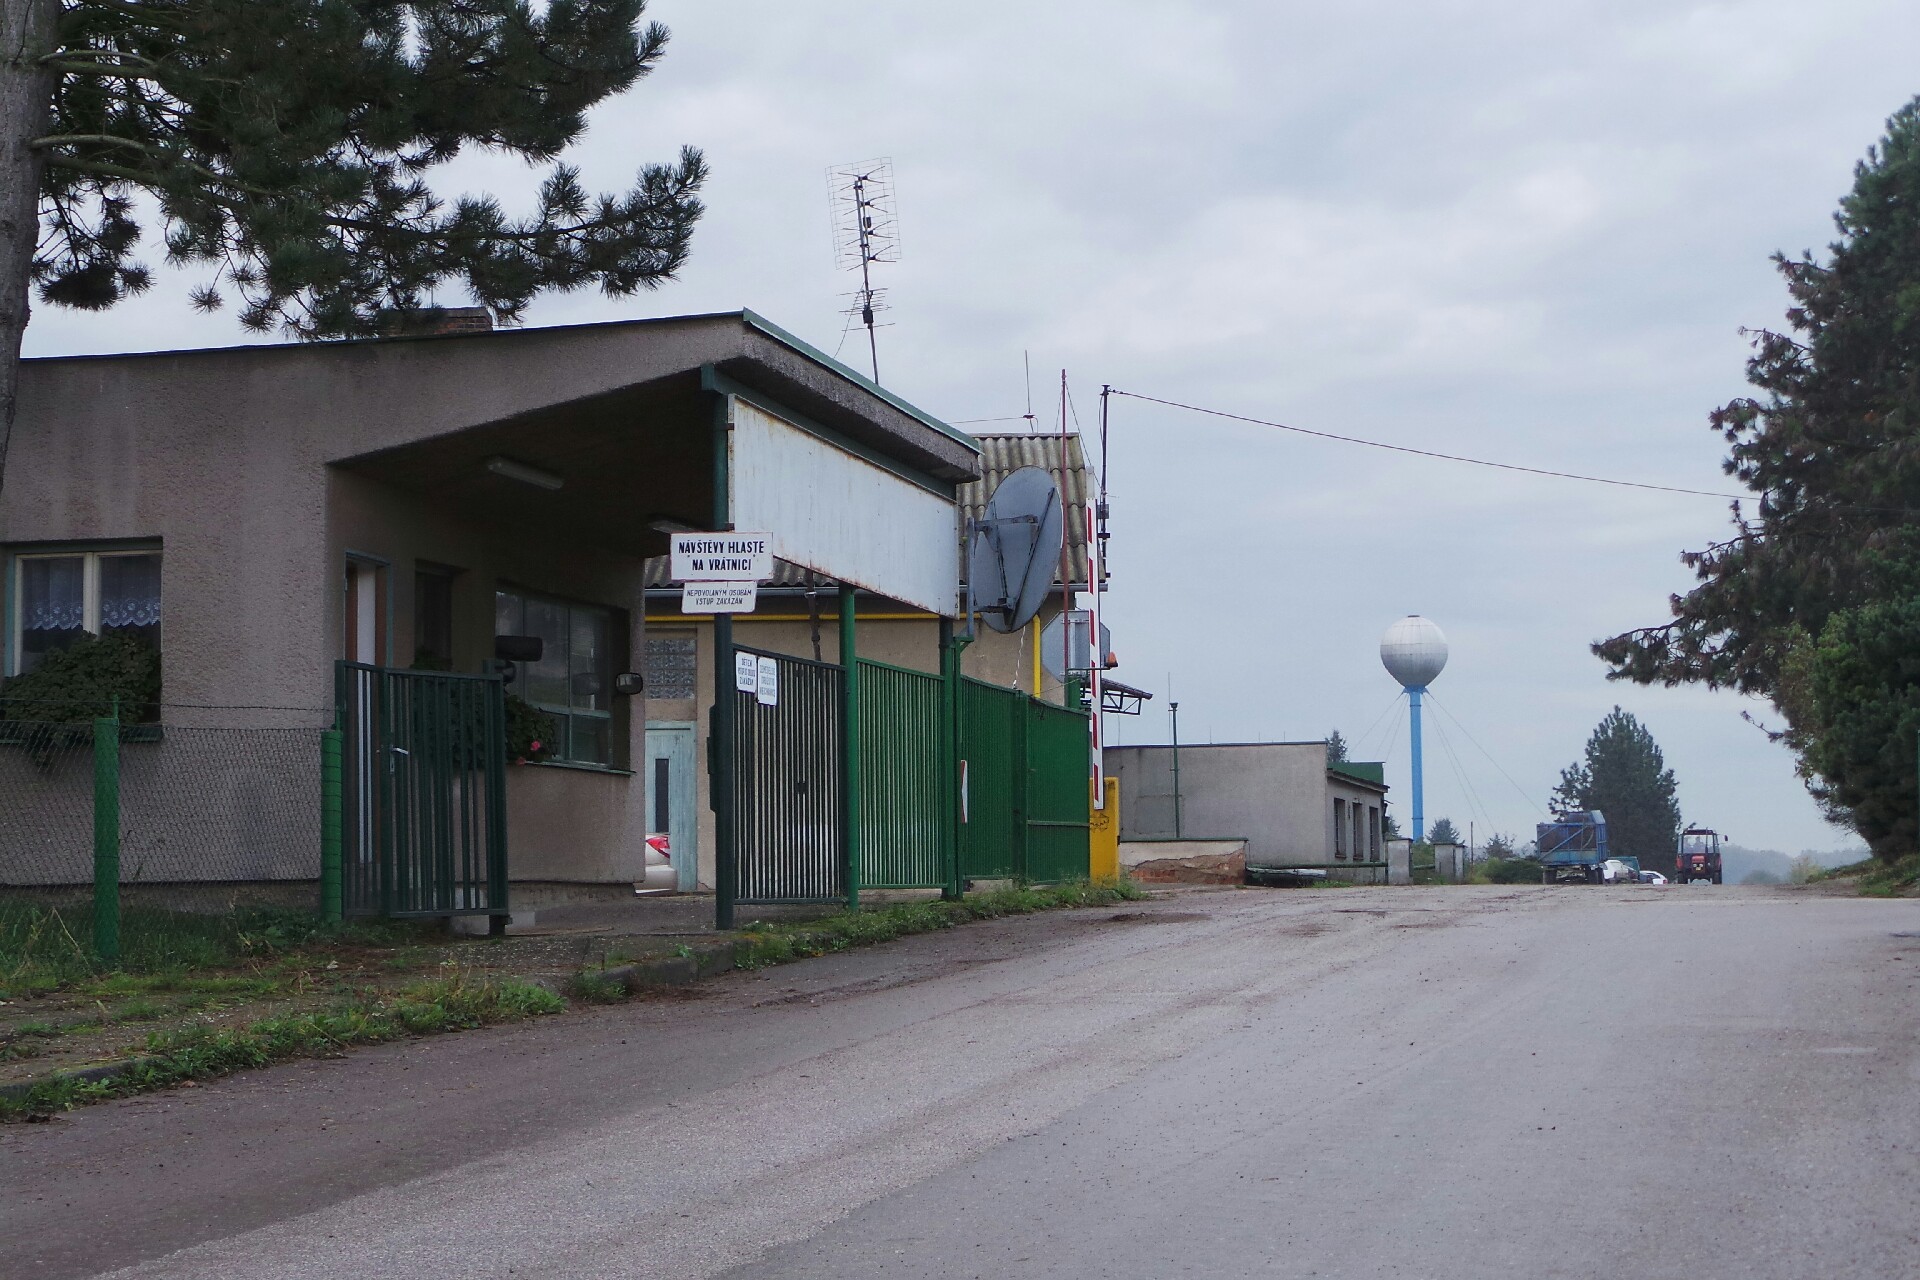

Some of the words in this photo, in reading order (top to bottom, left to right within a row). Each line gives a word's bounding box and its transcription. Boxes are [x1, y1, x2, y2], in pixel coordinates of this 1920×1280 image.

[728, 541, 764, 553] HLASTE
[692, 558, 704, 570] NA
[708, 557, 752, 570] VRÁTNICI
